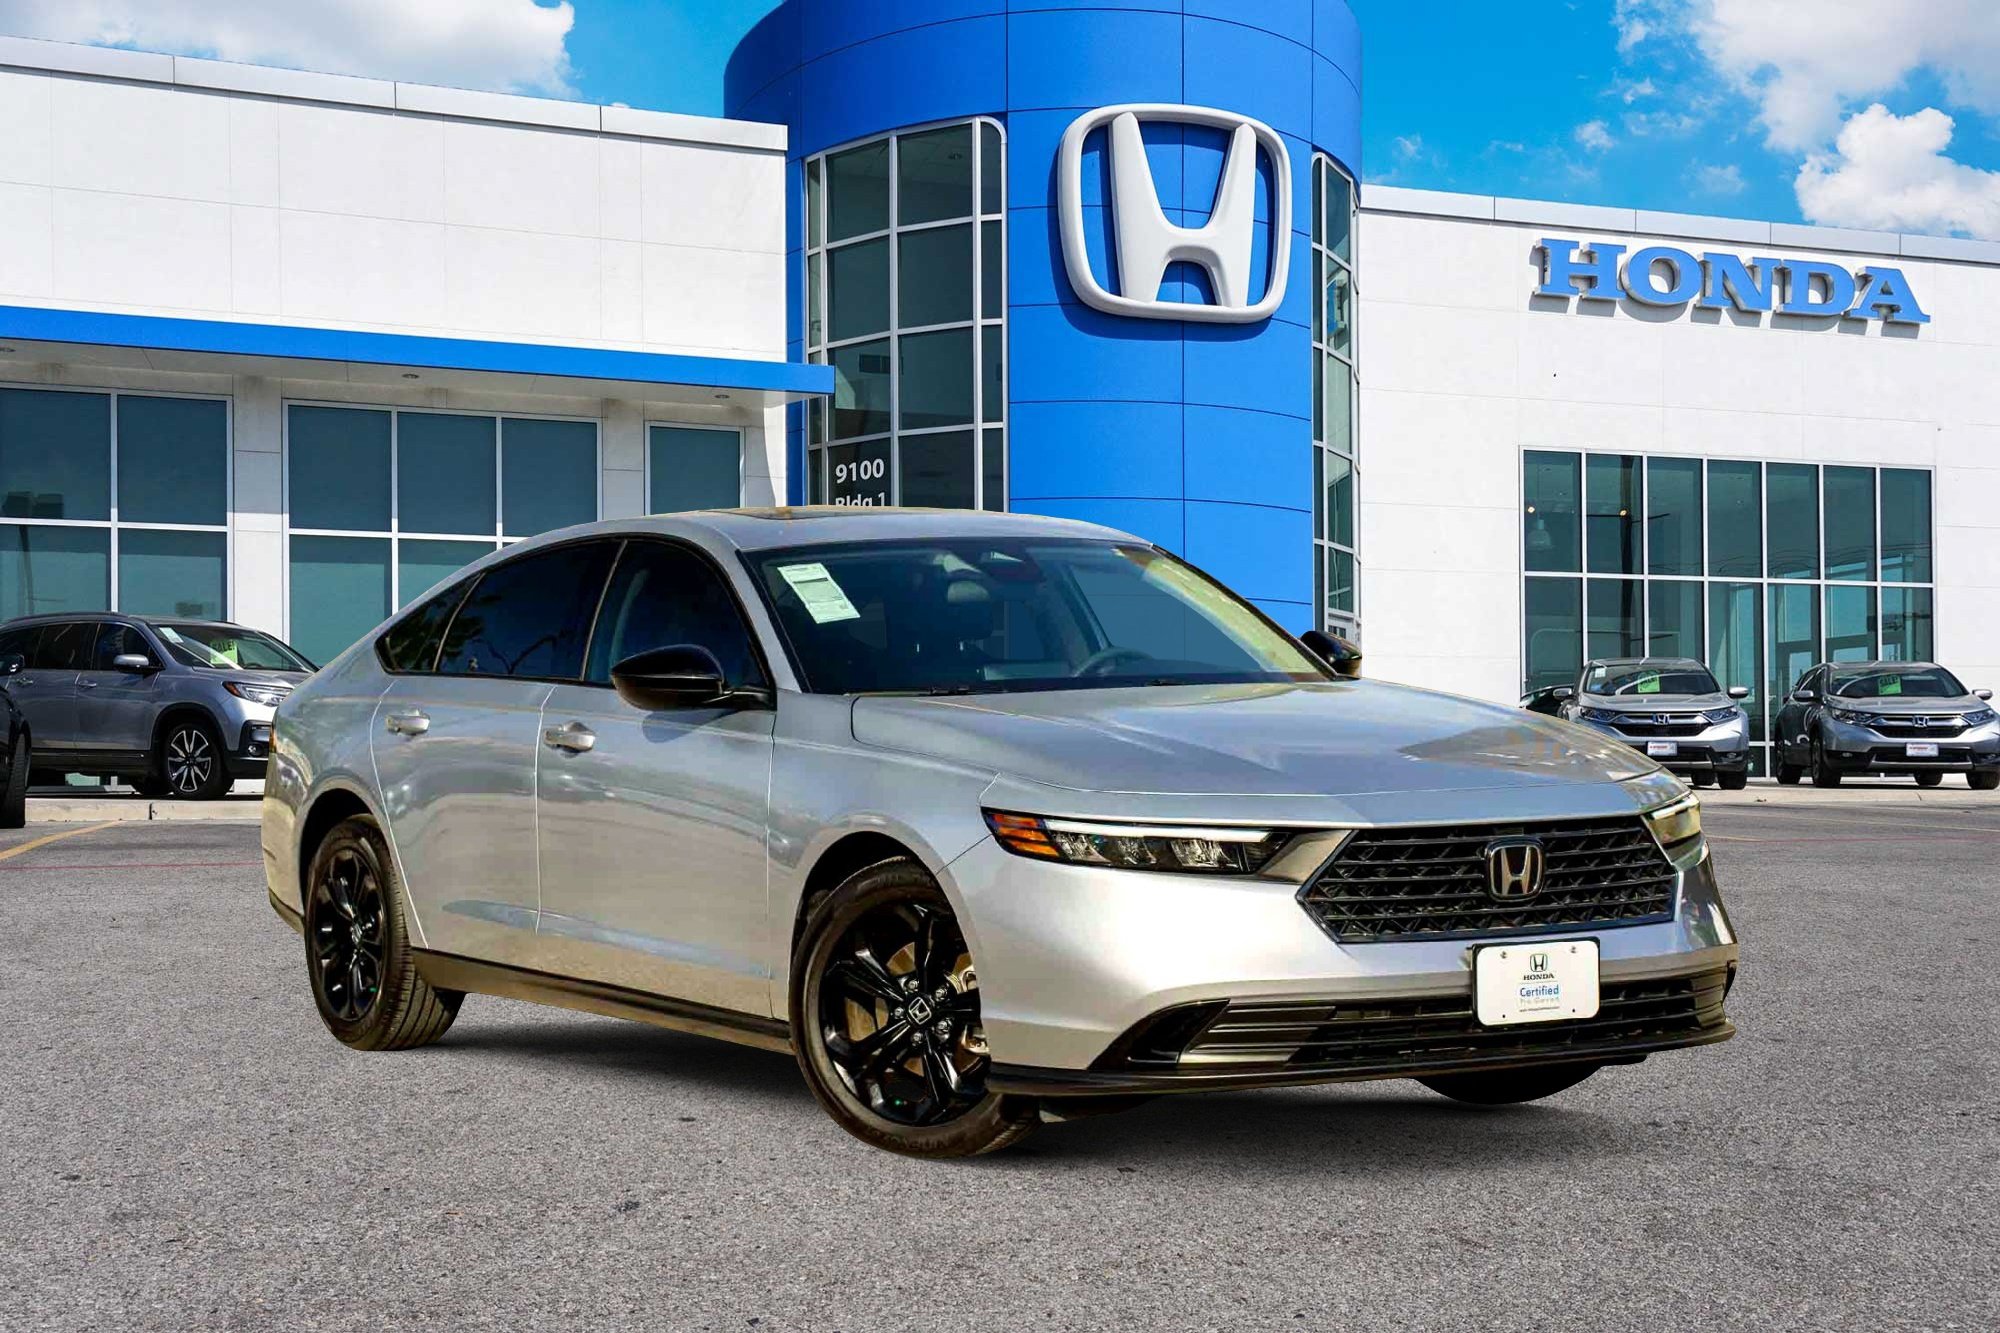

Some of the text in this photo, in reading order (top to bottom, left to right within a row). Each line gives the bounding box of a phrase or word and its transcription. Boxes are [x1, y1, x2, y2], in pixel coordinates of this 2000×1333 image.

[1533, 237, 1931, 325] HONDA
[835, 458, 885, 484] 9100
[878, 492, 886, 507] 1
[1523, 973, 1555, 981] HONDA
[1520, 984, 1560, 997] Certified
